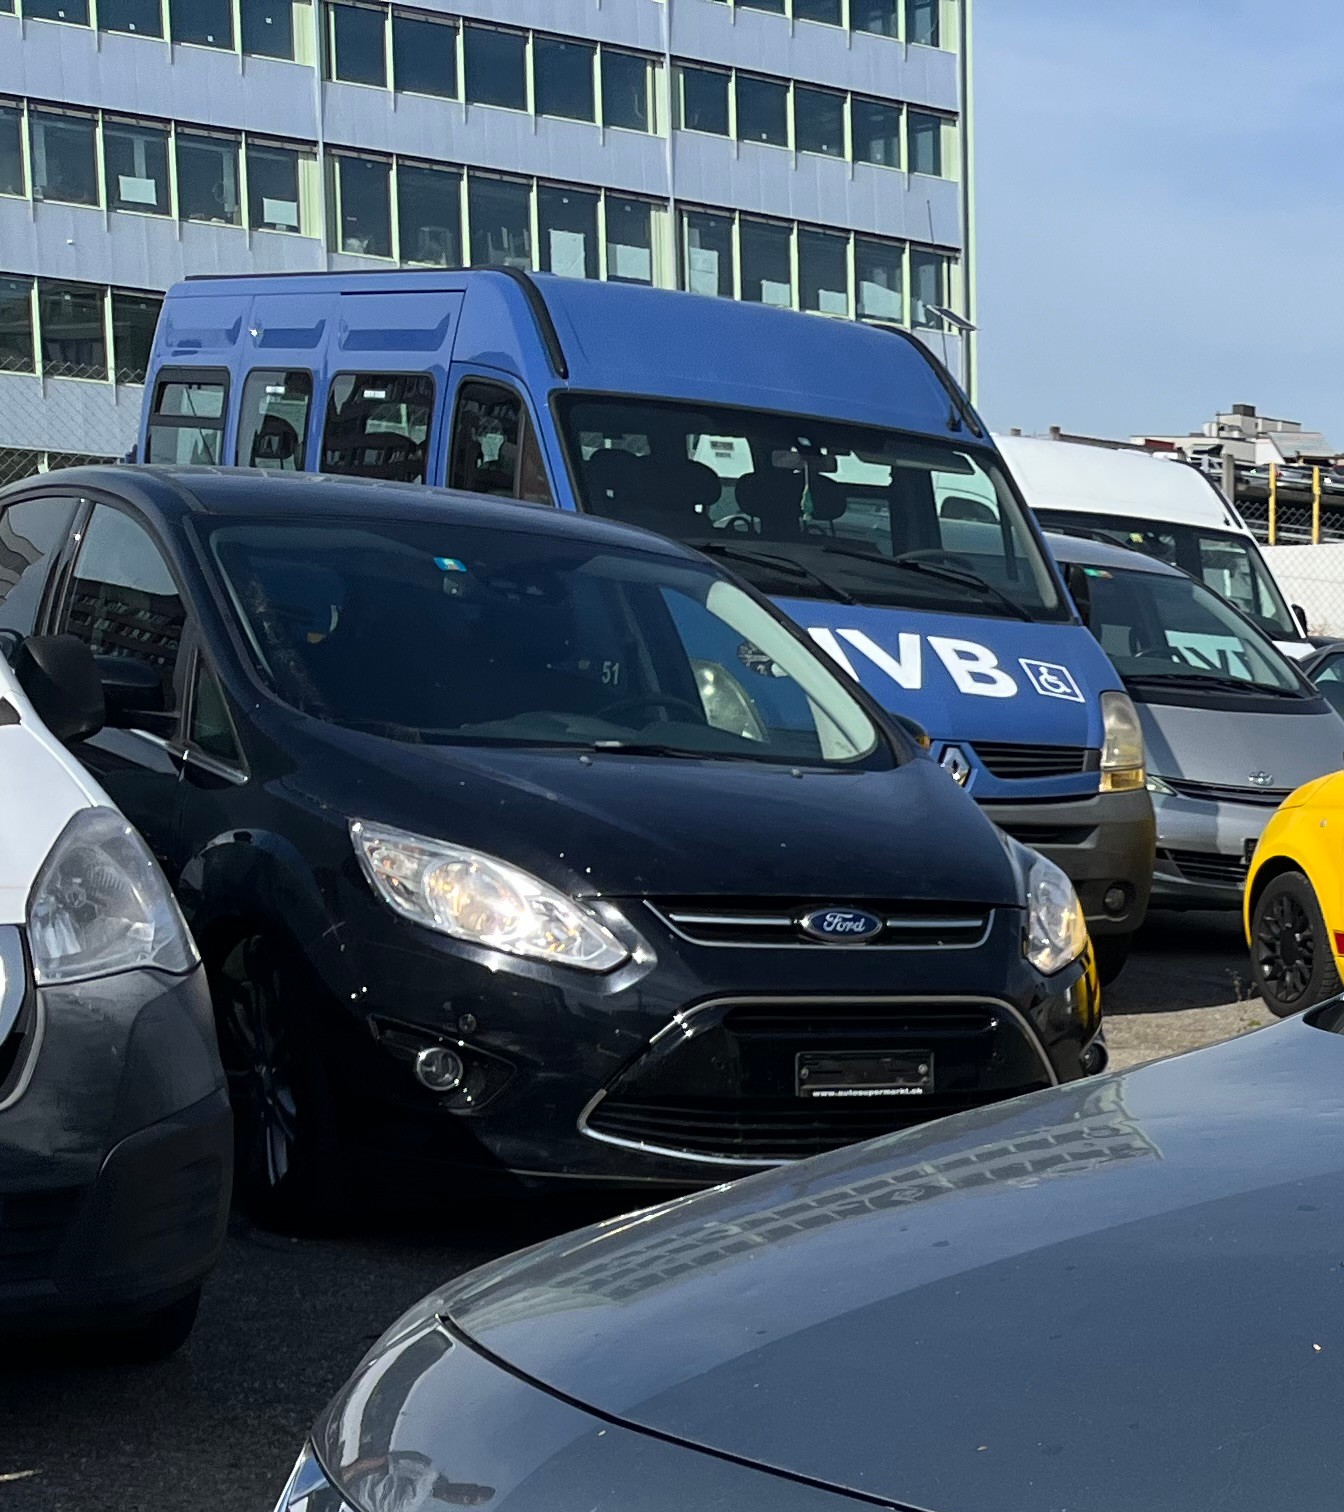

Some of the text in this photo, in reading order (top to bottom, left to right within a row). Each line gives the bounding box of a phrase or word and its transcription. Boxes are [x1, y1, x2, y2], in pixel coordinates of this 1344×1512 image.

[601, 661, 620, 685] 51
[807, 627, 1018, 698] IVB
[822, 912, 866, 932] Ford
